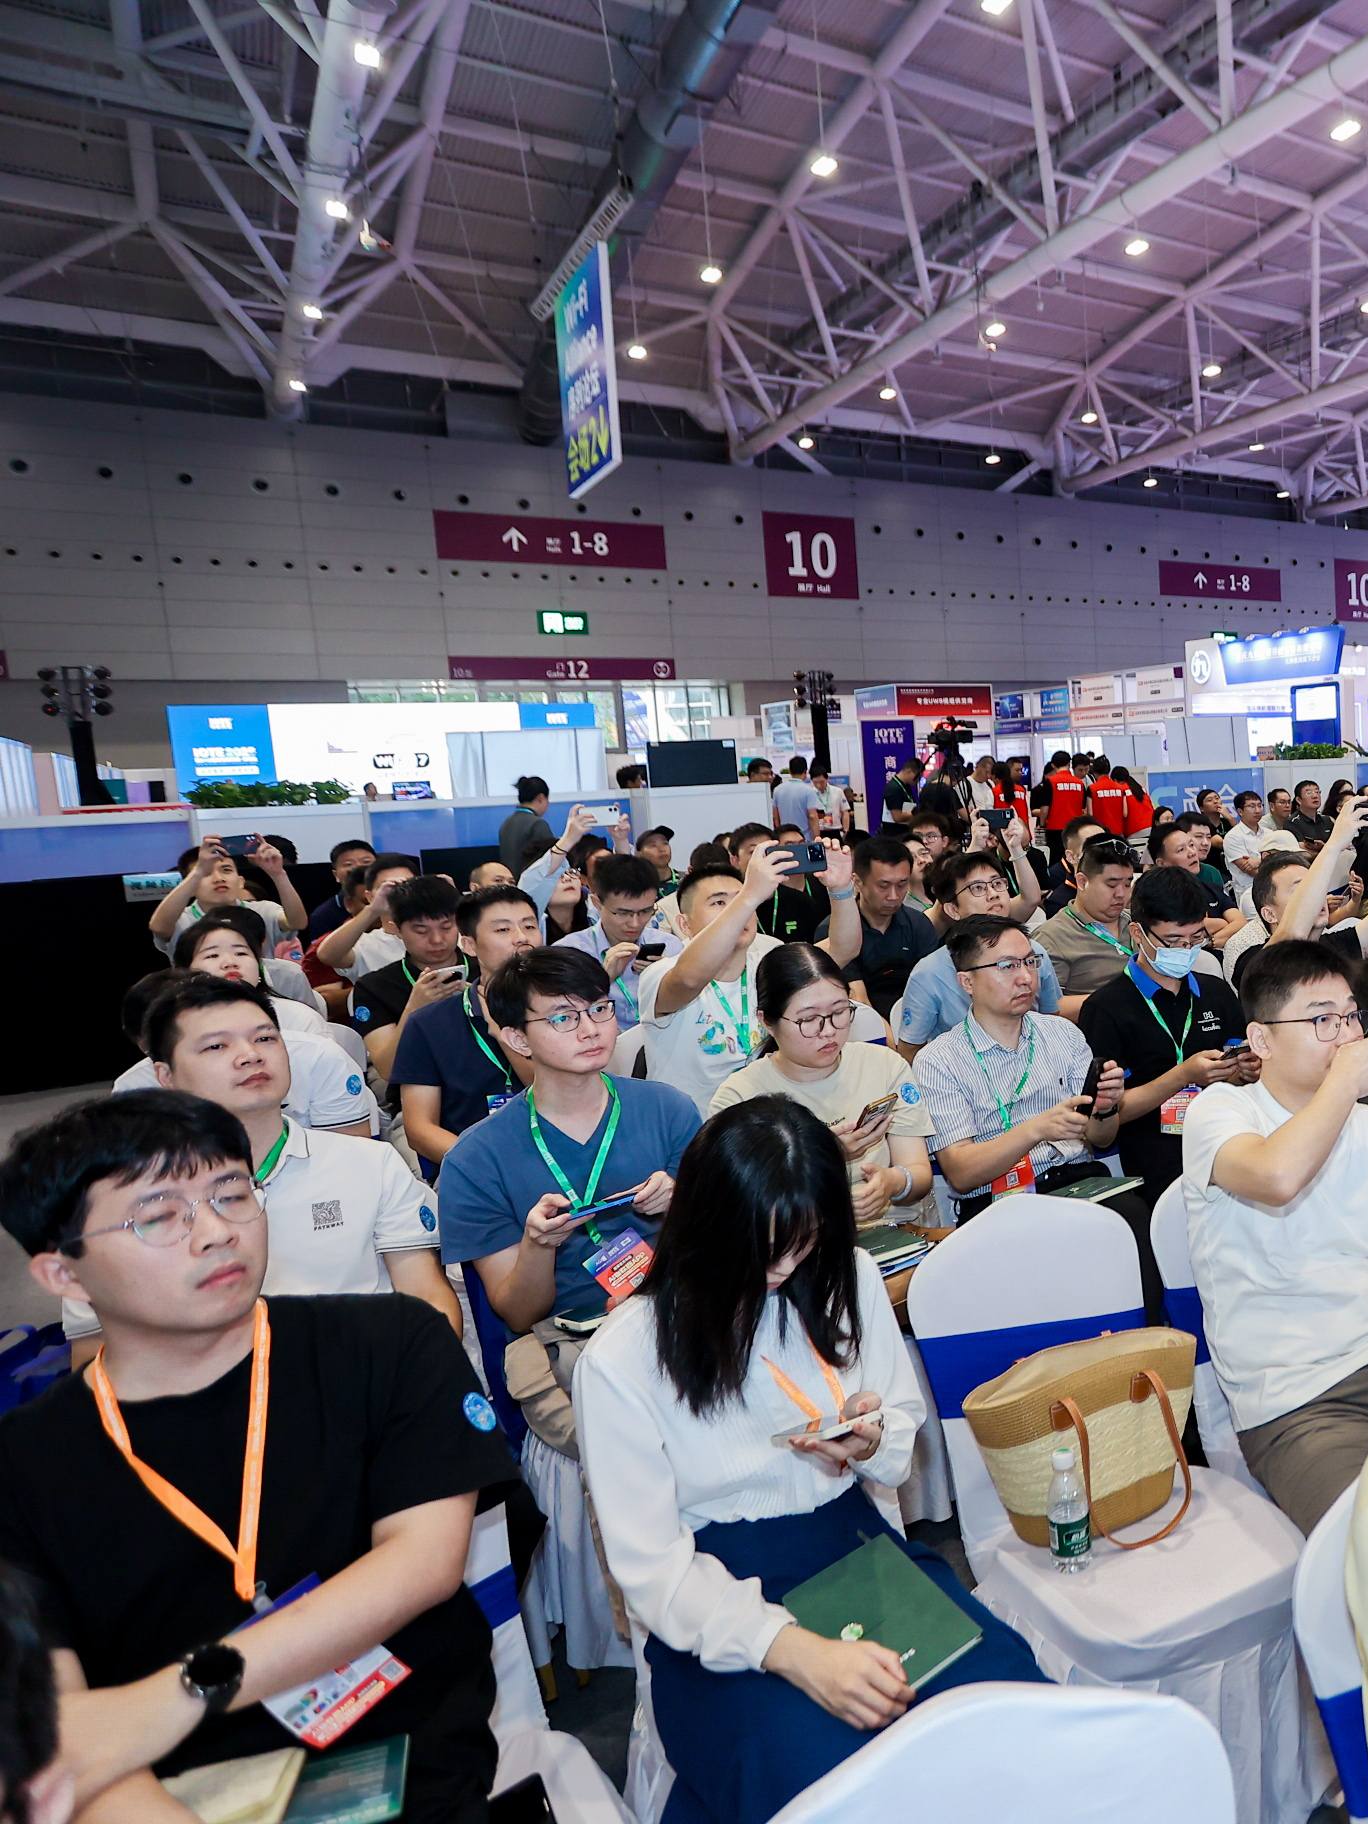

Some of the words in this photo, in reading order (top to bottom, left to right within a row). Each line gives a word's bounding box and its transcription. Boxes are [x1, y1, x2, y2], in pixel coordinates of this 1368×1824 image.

[570, 530, 609, 556] 1-8
[784, 531, 837, 579] 10
[817, 584, 831, 593] Hall
[1229, 574, 1250, 592] 1-8
[546, 670, 565, 678] Gate
[567, 660, 589, 679] 12
[874, 728, 903, 738] IOTE
[314, 1222, 344, 1231] PATHWAY
